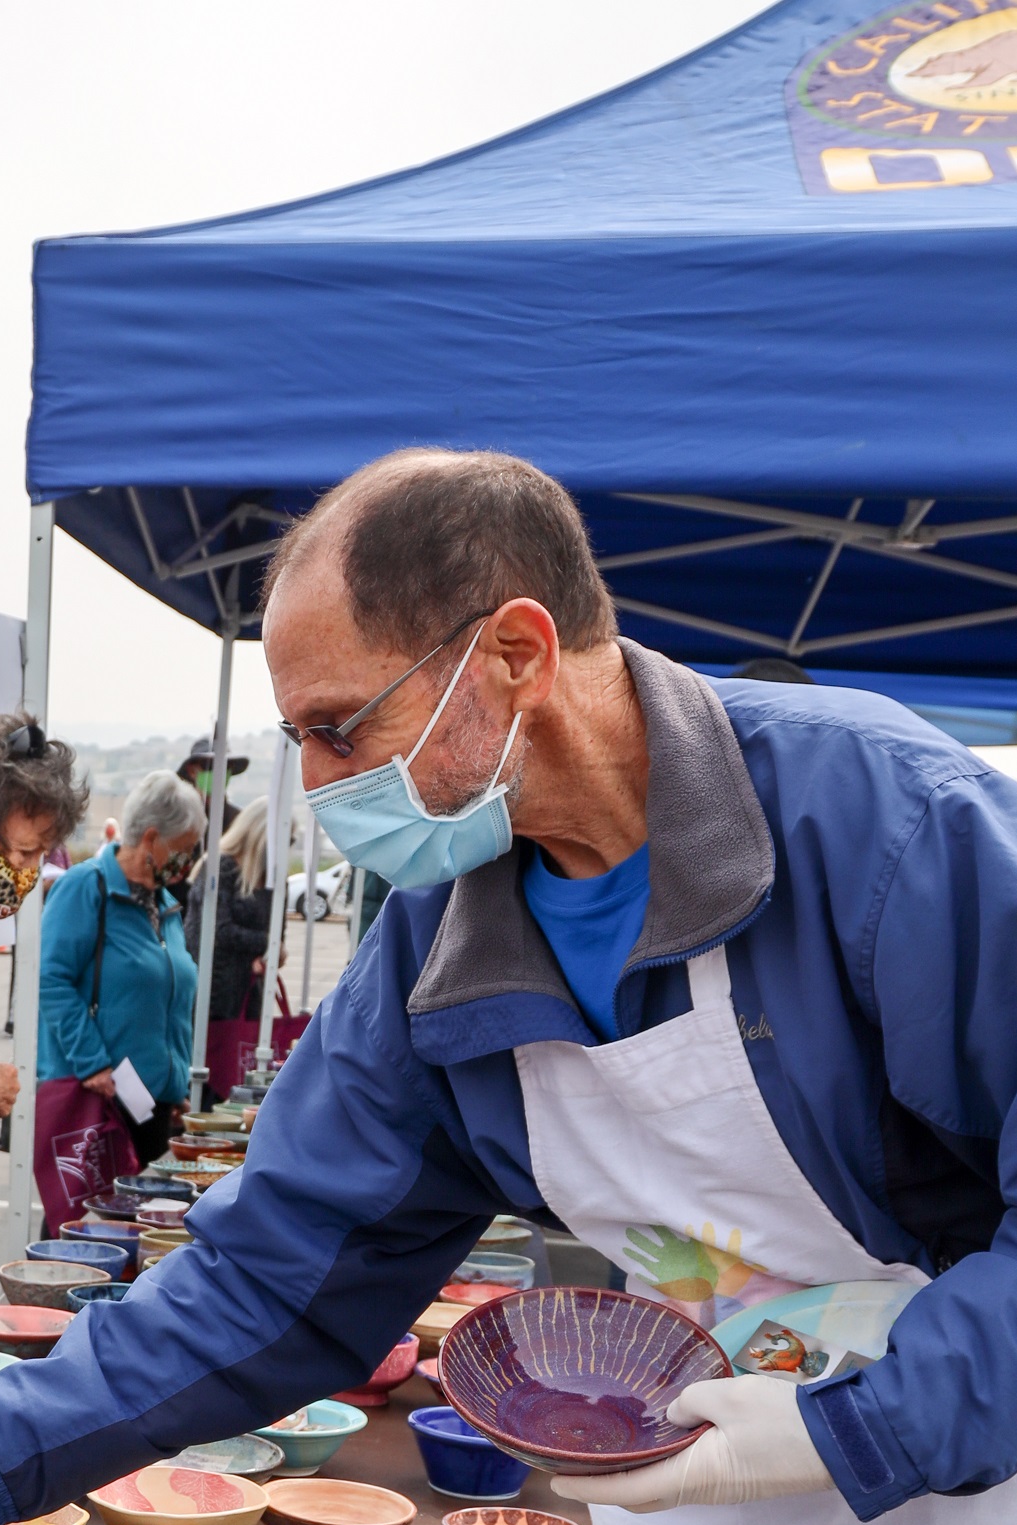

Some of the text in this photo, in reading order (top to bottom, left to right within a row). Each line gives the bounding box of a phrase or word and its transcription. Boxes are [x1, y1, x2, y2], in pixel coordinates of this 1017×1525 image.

[826, 0, 992, 77] CALI
[825, 91, 1010, 136] STAT
[738, 1013, 775, 1041] bela
